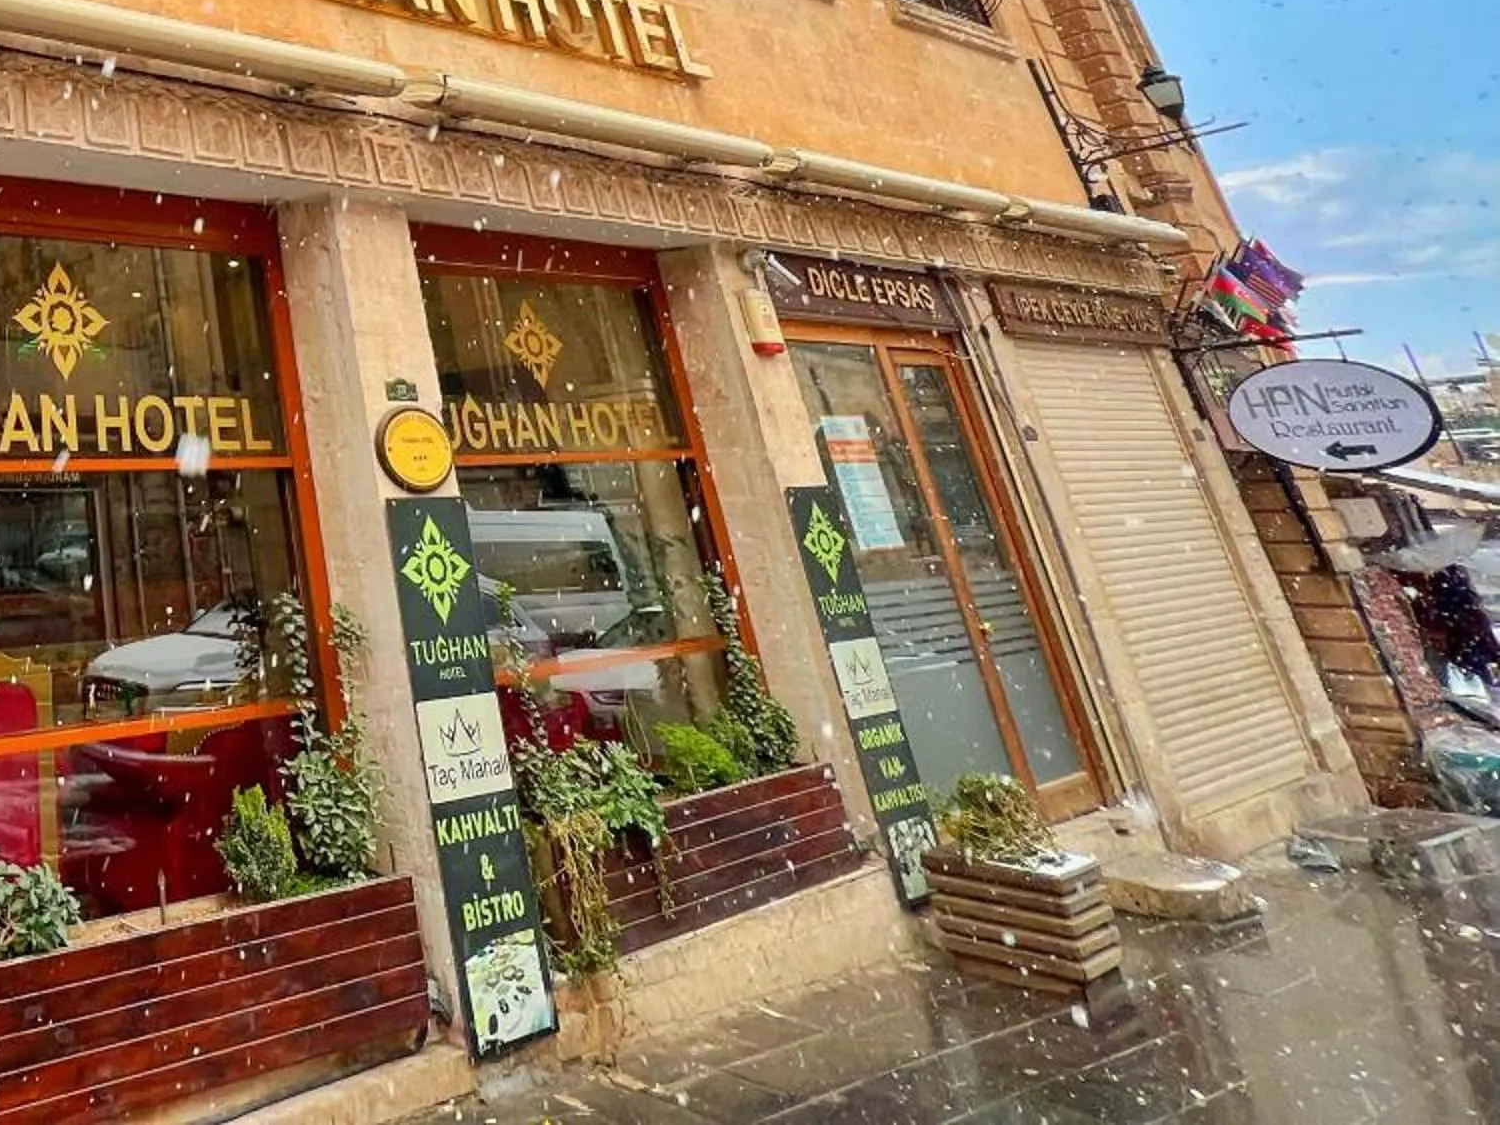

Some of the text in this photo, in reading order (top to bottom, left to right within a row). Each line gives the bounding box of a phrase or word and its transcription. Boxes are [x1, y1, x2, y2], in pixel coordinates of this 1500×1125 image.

[95, 394, 272, 452] HOTEL
[566, 401, 678, 449] HOTEL
[436, 805, 521, 847] KAHVALTI
[480, 853, 495, 880] &
